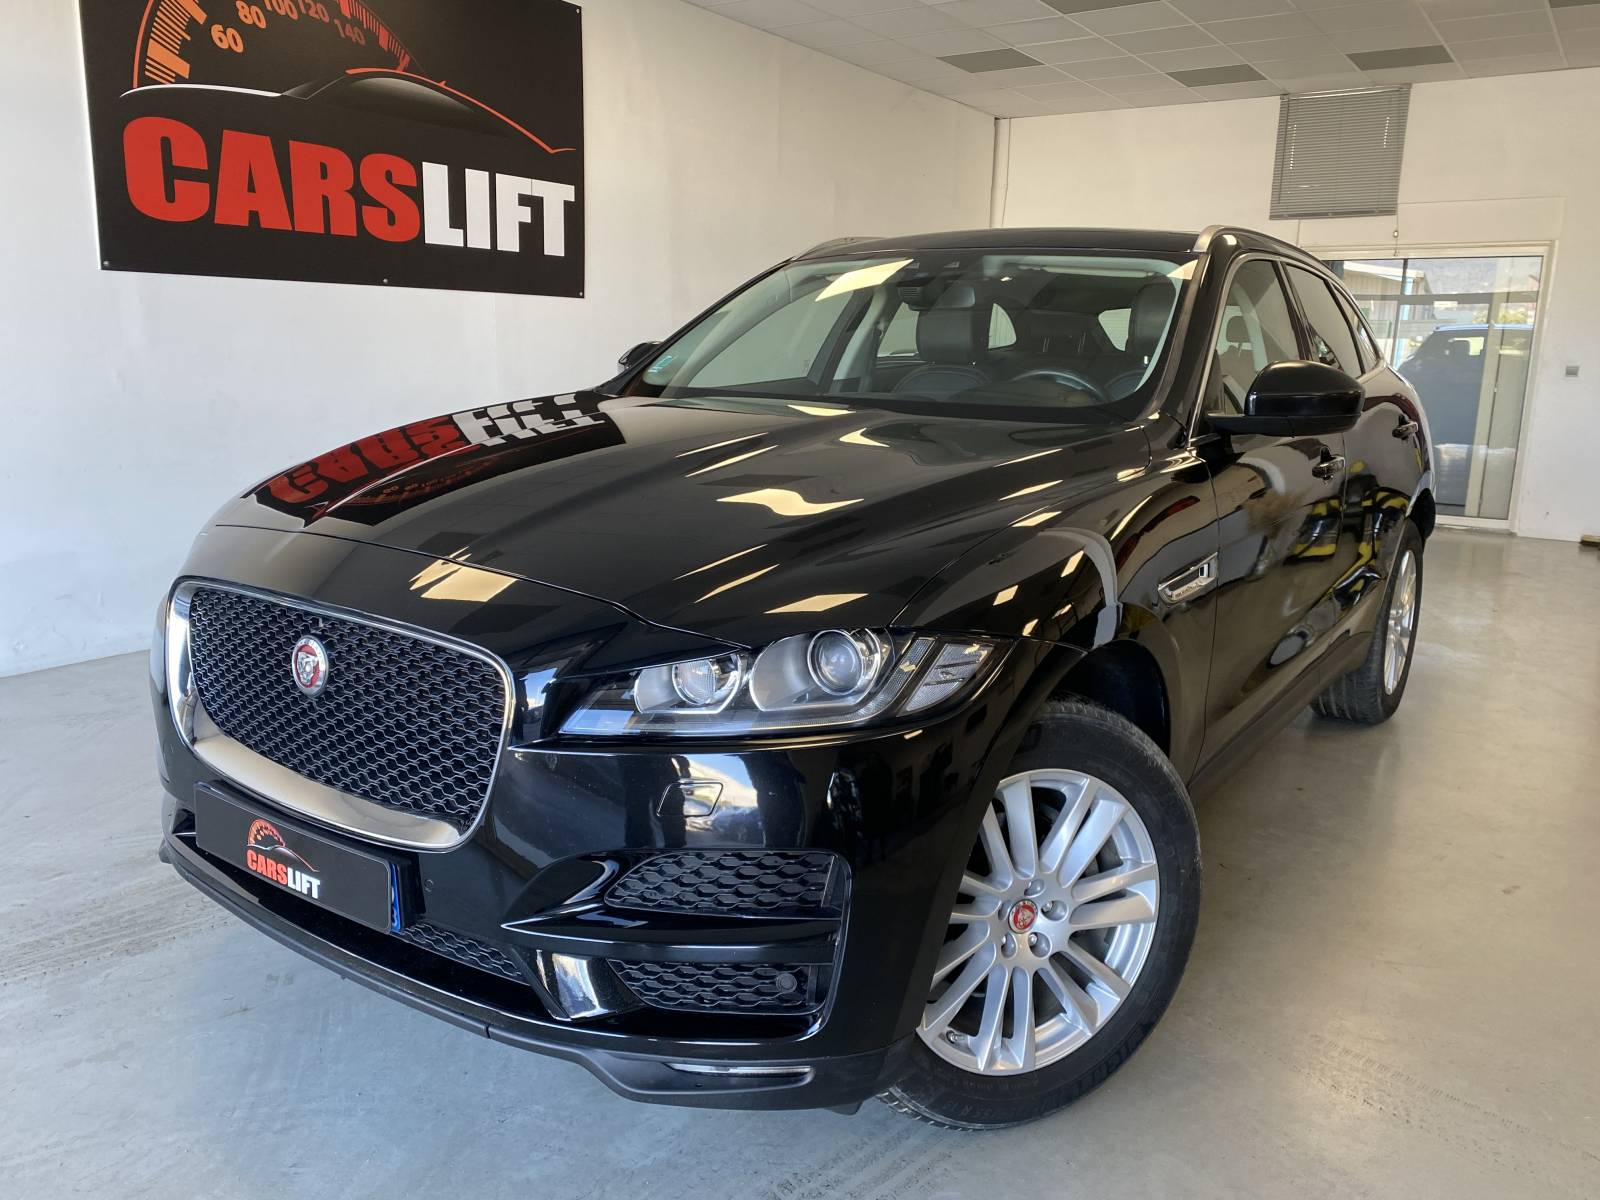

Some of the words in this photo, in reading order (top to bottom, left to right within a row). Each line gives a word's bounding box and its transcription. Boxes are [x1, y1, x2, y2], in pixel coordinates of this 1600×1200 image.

[236, 0, 267, 29] 80
[298, 0, 330, 23] 120
[210, 23, 244, 54] 60
[333, 18, 366, 46] 140
[122, 116, 576, 257] CARSLIFT
[246, 848, 321, 900] CARSLIFT
